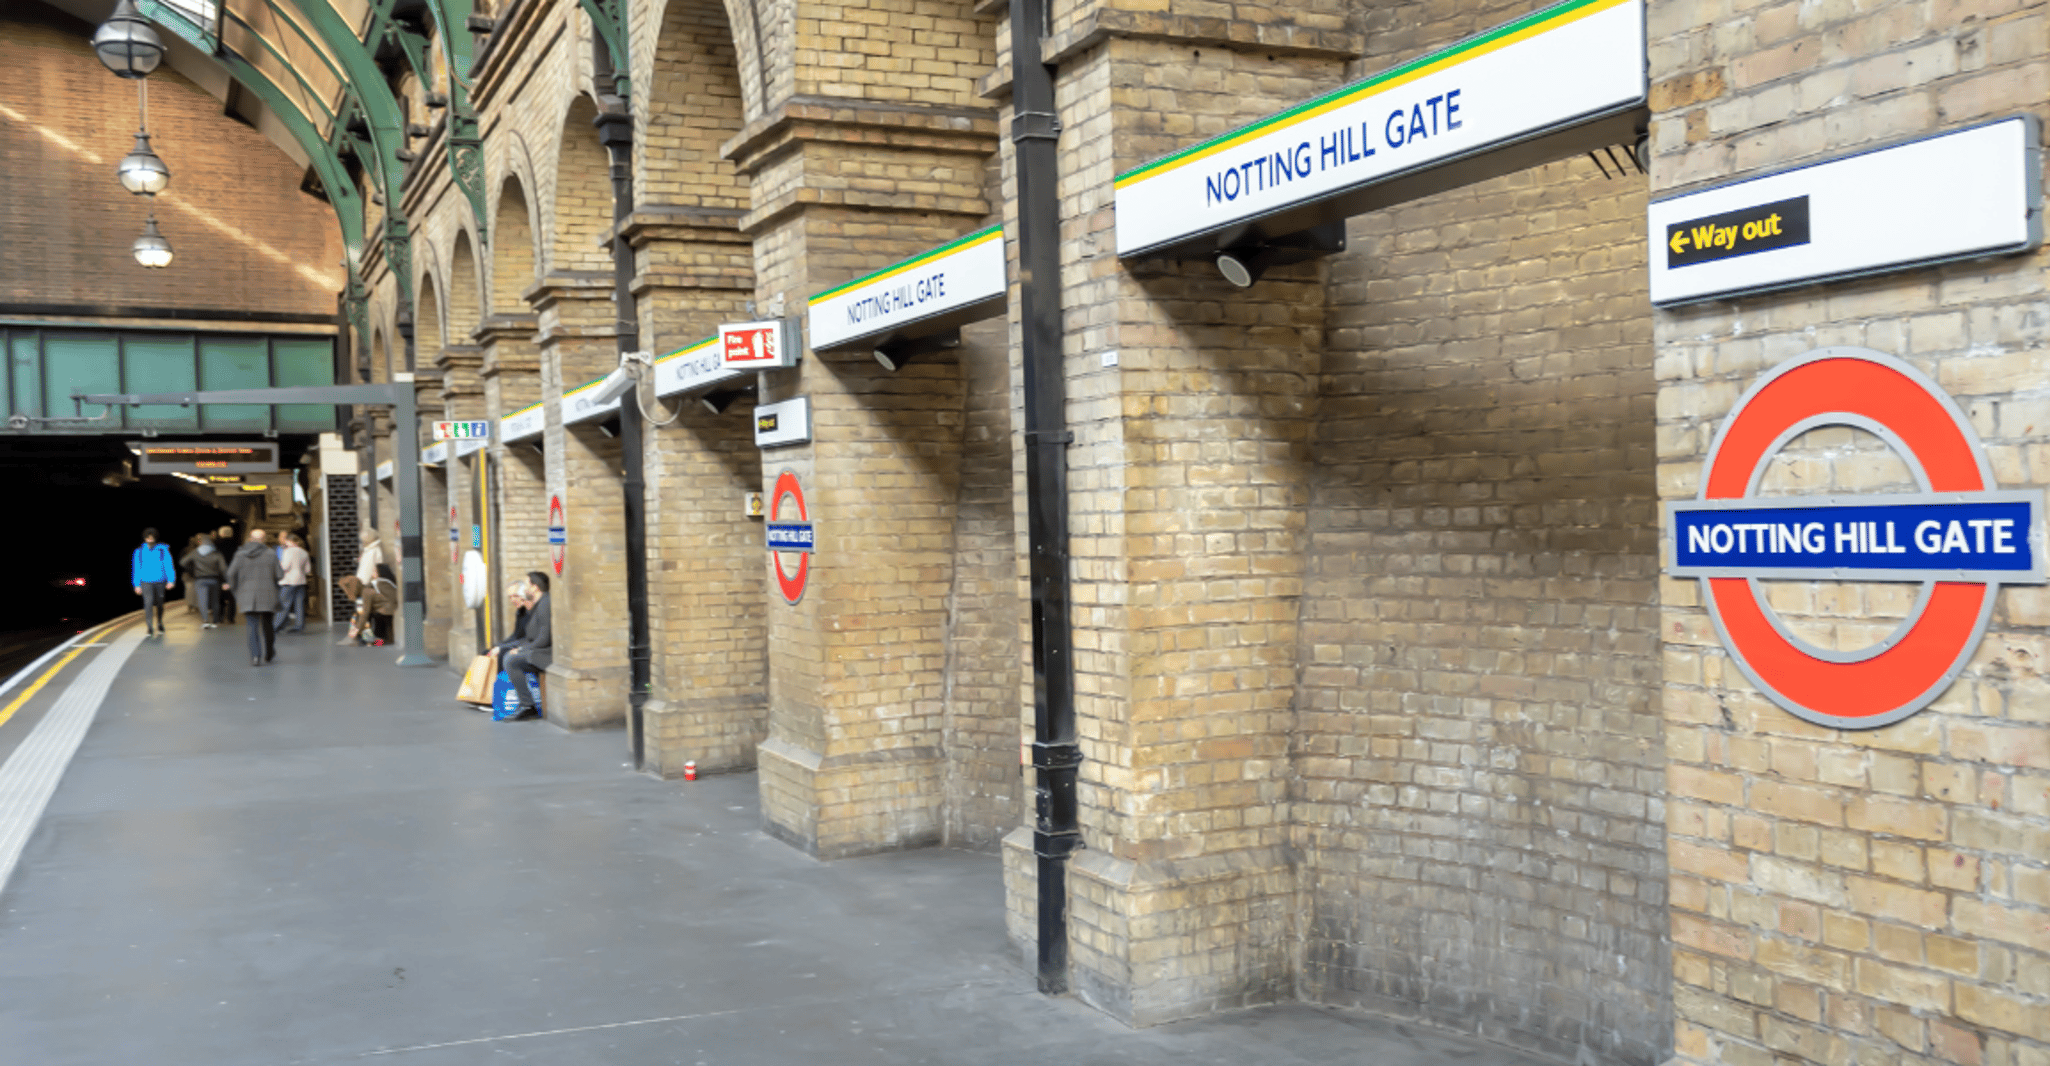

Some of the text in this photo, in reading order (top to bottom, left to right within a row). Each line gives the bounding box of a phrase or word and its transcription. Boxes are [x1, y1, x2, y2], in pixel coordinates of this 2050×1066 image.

[1206, 88, 1463, 208] NOTTING HILL GATE
[1691, 213, 1783, 250] Way out
[847, 273, 946, 326] NOTTING HILL GATE
[1687, 519, 2017, 555] NOTTING HILL GATE
